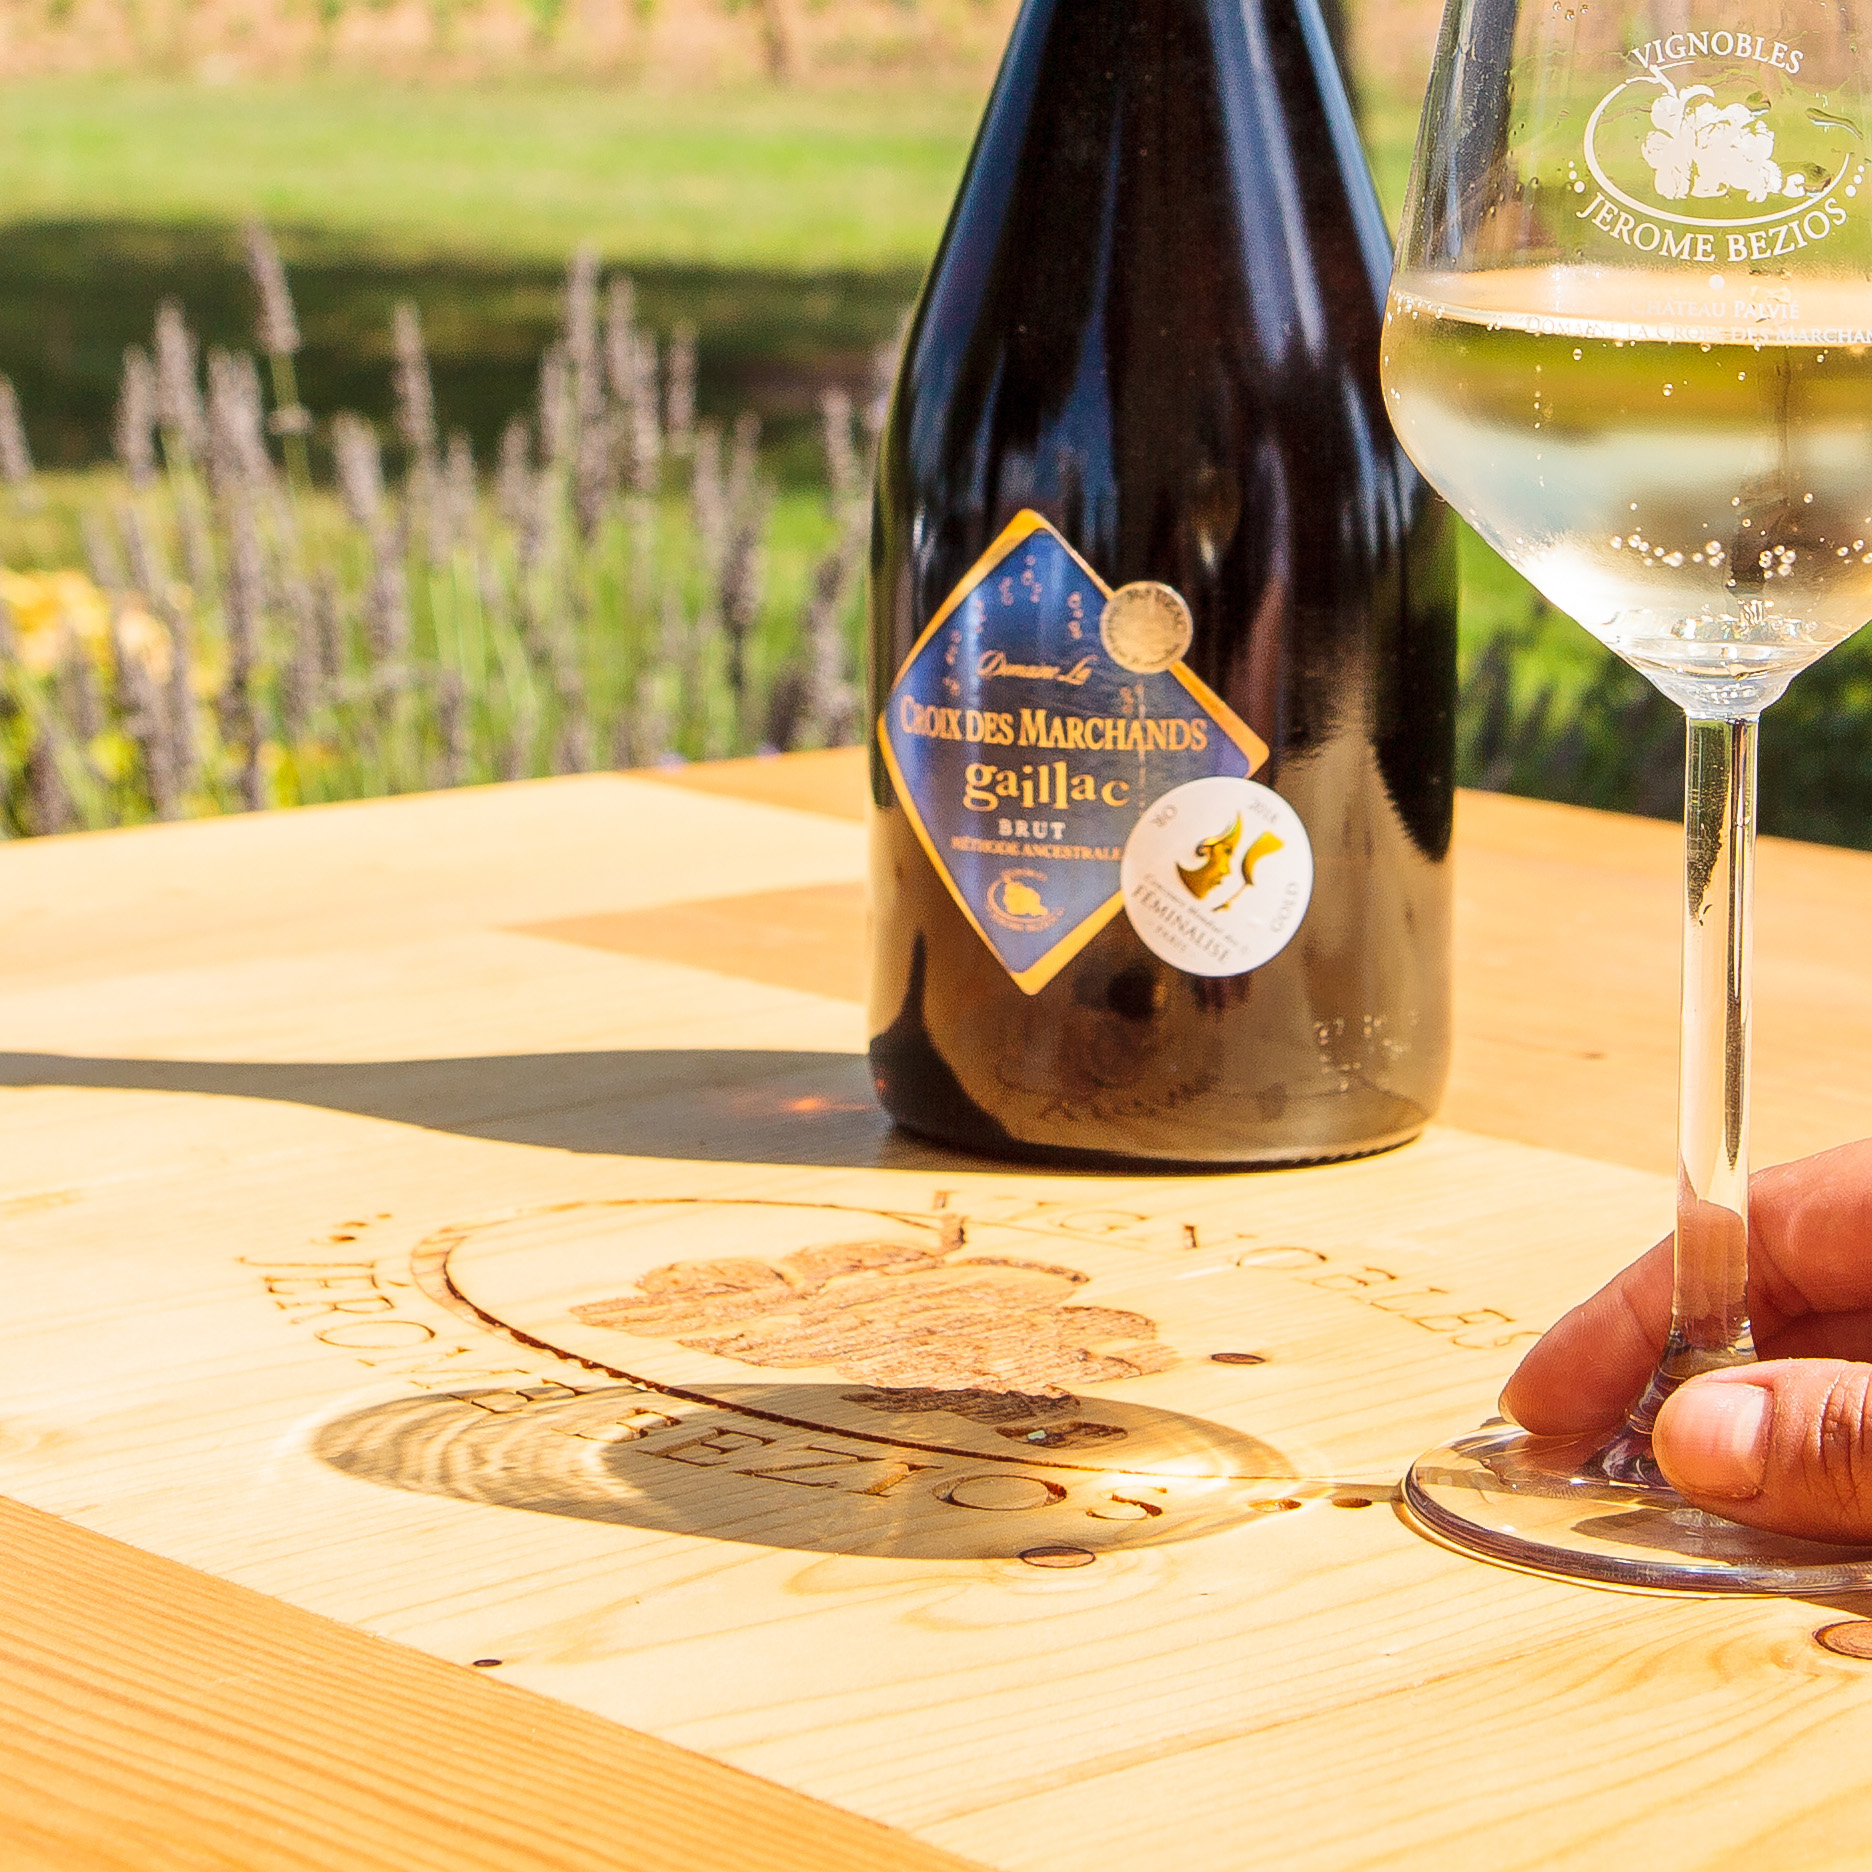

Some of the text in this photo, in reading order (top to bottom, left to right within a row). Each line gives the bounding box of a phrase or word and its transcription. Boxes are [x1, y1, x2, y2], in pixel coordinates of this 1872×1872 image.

[1631, 30, 1805, 75] VIGNOBLES
[1575, 191, 1848, 263] JEROME BEZIOS
[966, 708, 1014, 746] DES
[1017, 707, 1209, 752] MARCHANDS
[962, 760, 1130, 812] gaillac
[997, 817, 1067, 840] BRUT
